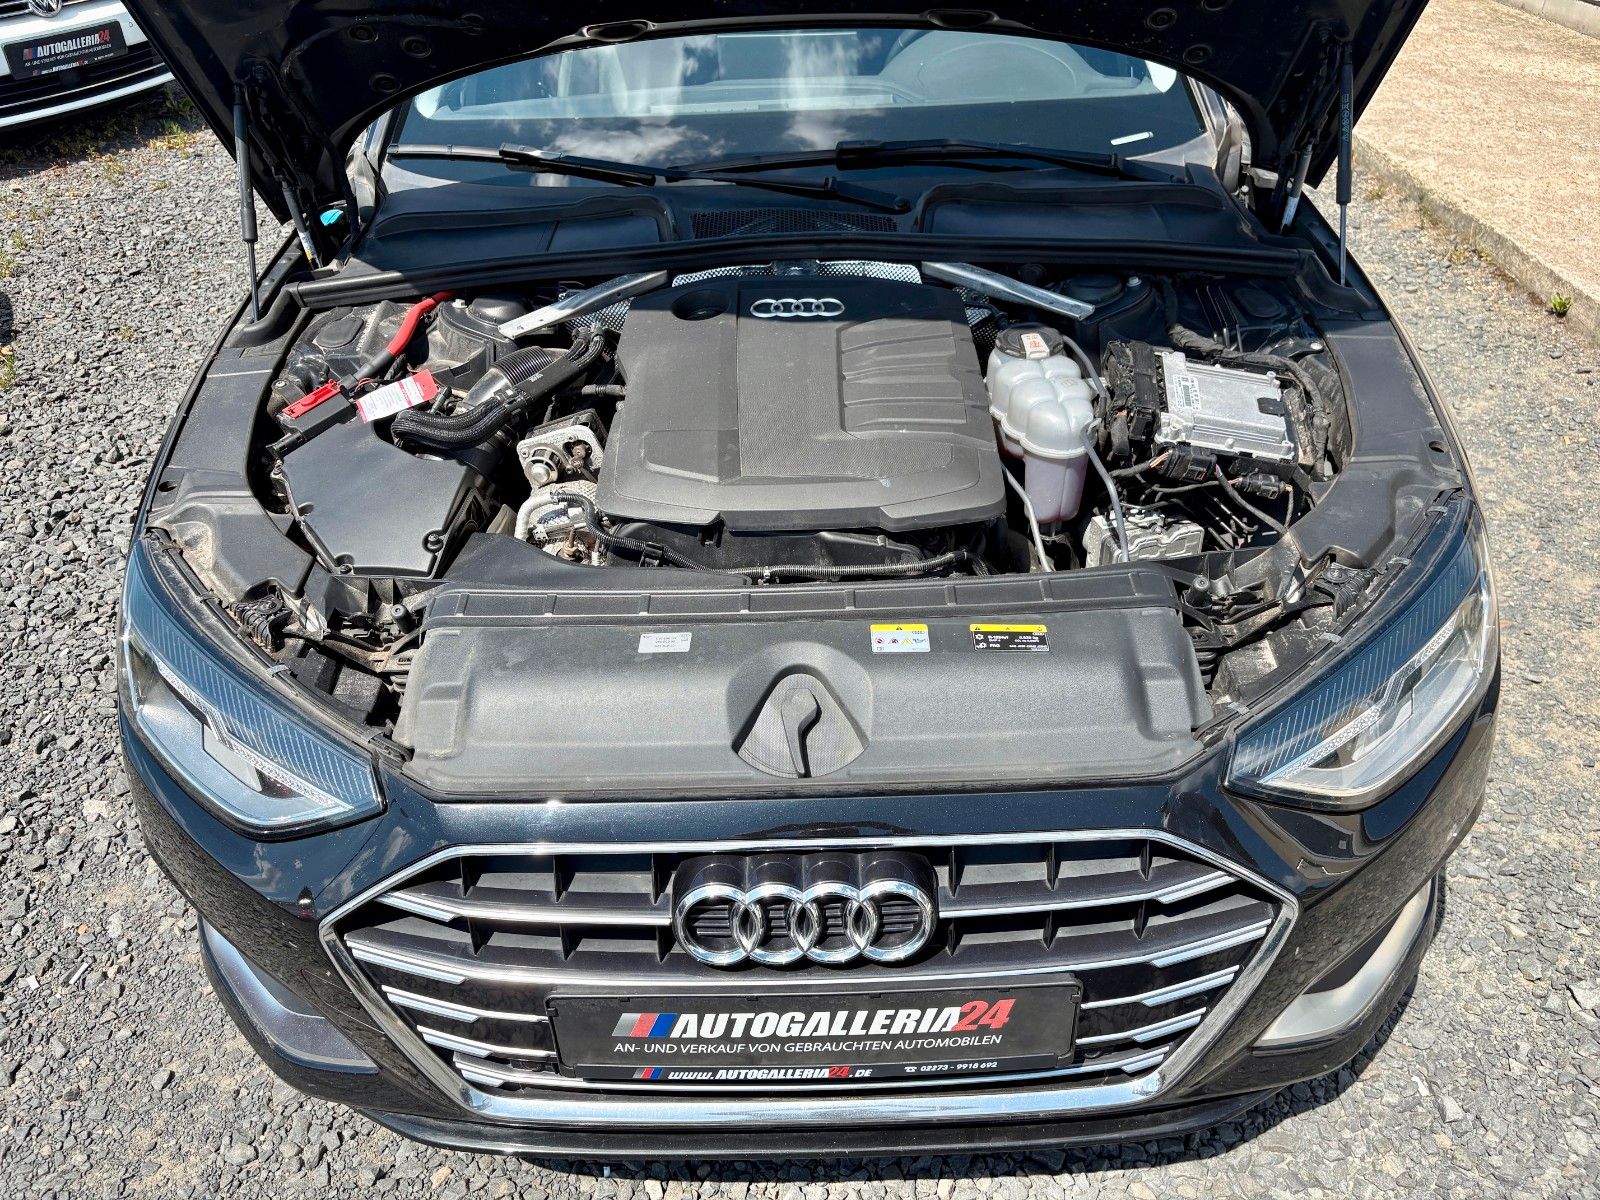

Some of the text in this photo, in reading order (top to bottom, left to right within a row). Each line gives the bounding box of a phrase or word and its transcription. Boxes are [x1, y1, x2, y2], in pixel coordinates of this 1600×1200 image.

[37, 29, 110, 57] AUTOGALLERIA24
[669, 998, 1017, 1039] AUTOGALLERIA24
[613, 1034, 1002, 1054] AN- UND VERKAUF VON GEBRAUCHTEN AUTOMOBILEN
[920, 1064, 948, 1072] 02273
[956, 1063, 979, 1071] 9918
